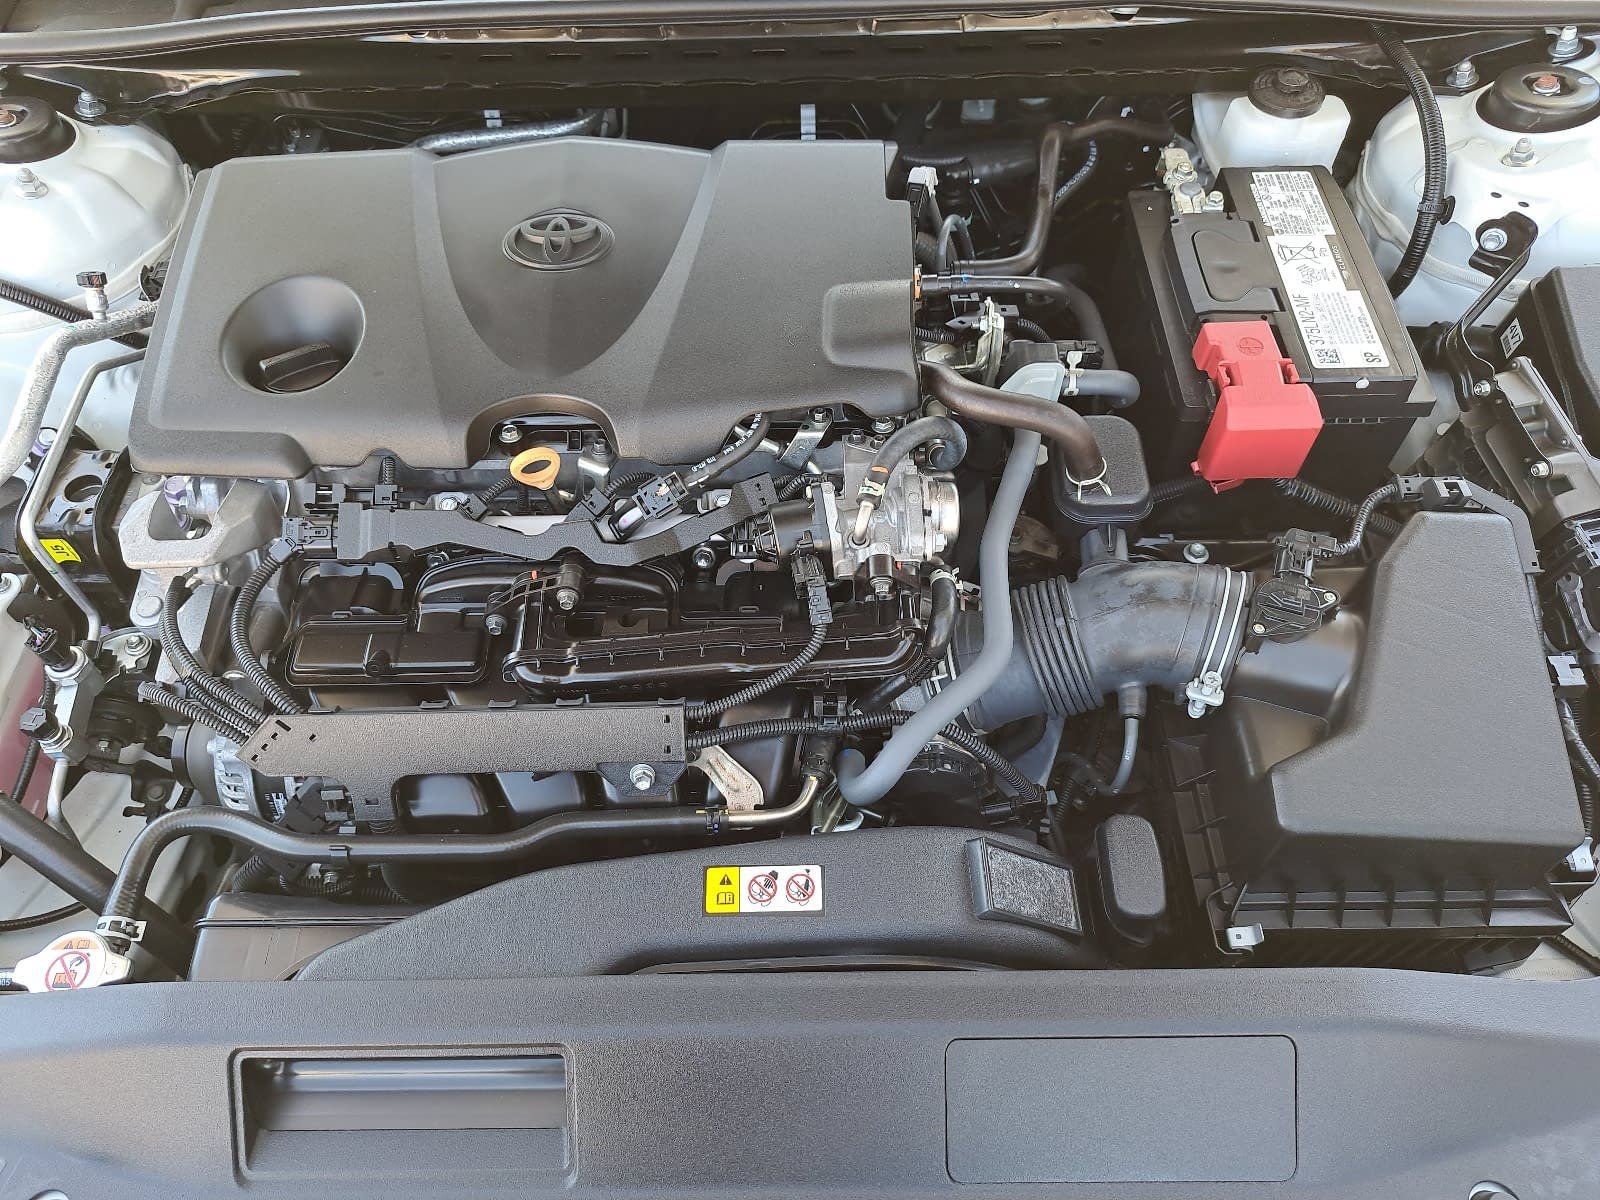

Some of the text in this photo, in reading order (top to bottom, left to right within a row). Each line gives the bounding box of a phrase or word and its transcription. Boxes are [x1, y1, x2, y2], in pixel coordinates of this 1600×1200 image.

[1332, 245, 1346, 272] CLARIOS
[1293, 294, 1325, 346] 375LN2-MF
[1509, 325, 1521, 345] 4V7
[1363, 352, 1382, 363] SP
